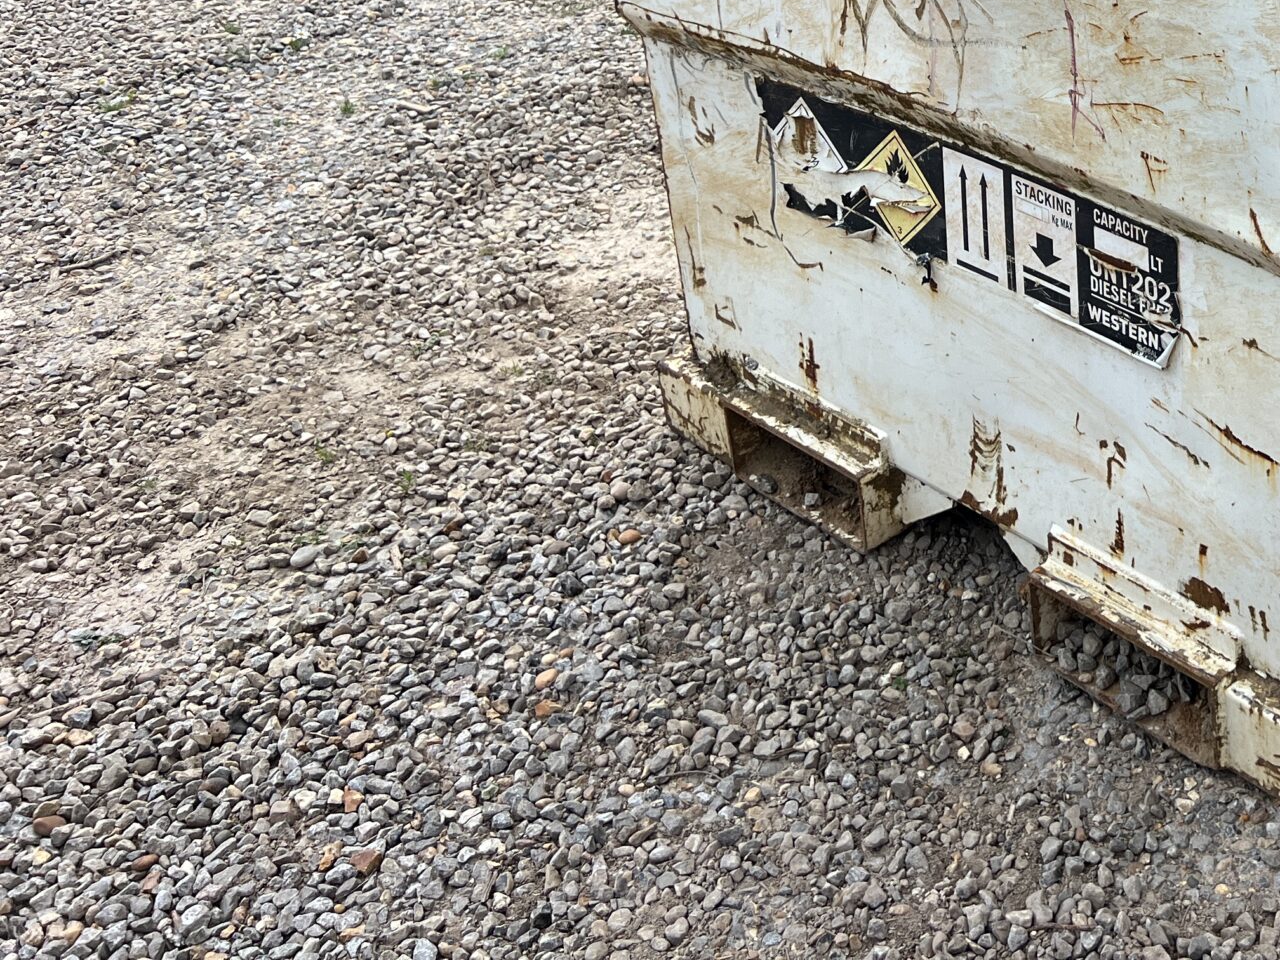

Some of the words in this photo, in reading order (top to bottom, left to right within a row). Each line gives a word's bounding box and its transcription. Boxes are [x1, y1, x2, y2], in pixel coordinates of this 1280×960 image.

[1014, 180, 1073, 217] STACKING
[897, 226, 903, 235] 3
[1060, 218, 1074, 231] MAX
[1093, 208, 1149, 244] CAPACITY
[1150, 254, 1164, 274] LT
[1090, 274, 1136, 310] DIESEL
[1087, 301, 1159, 351] WESTERN
